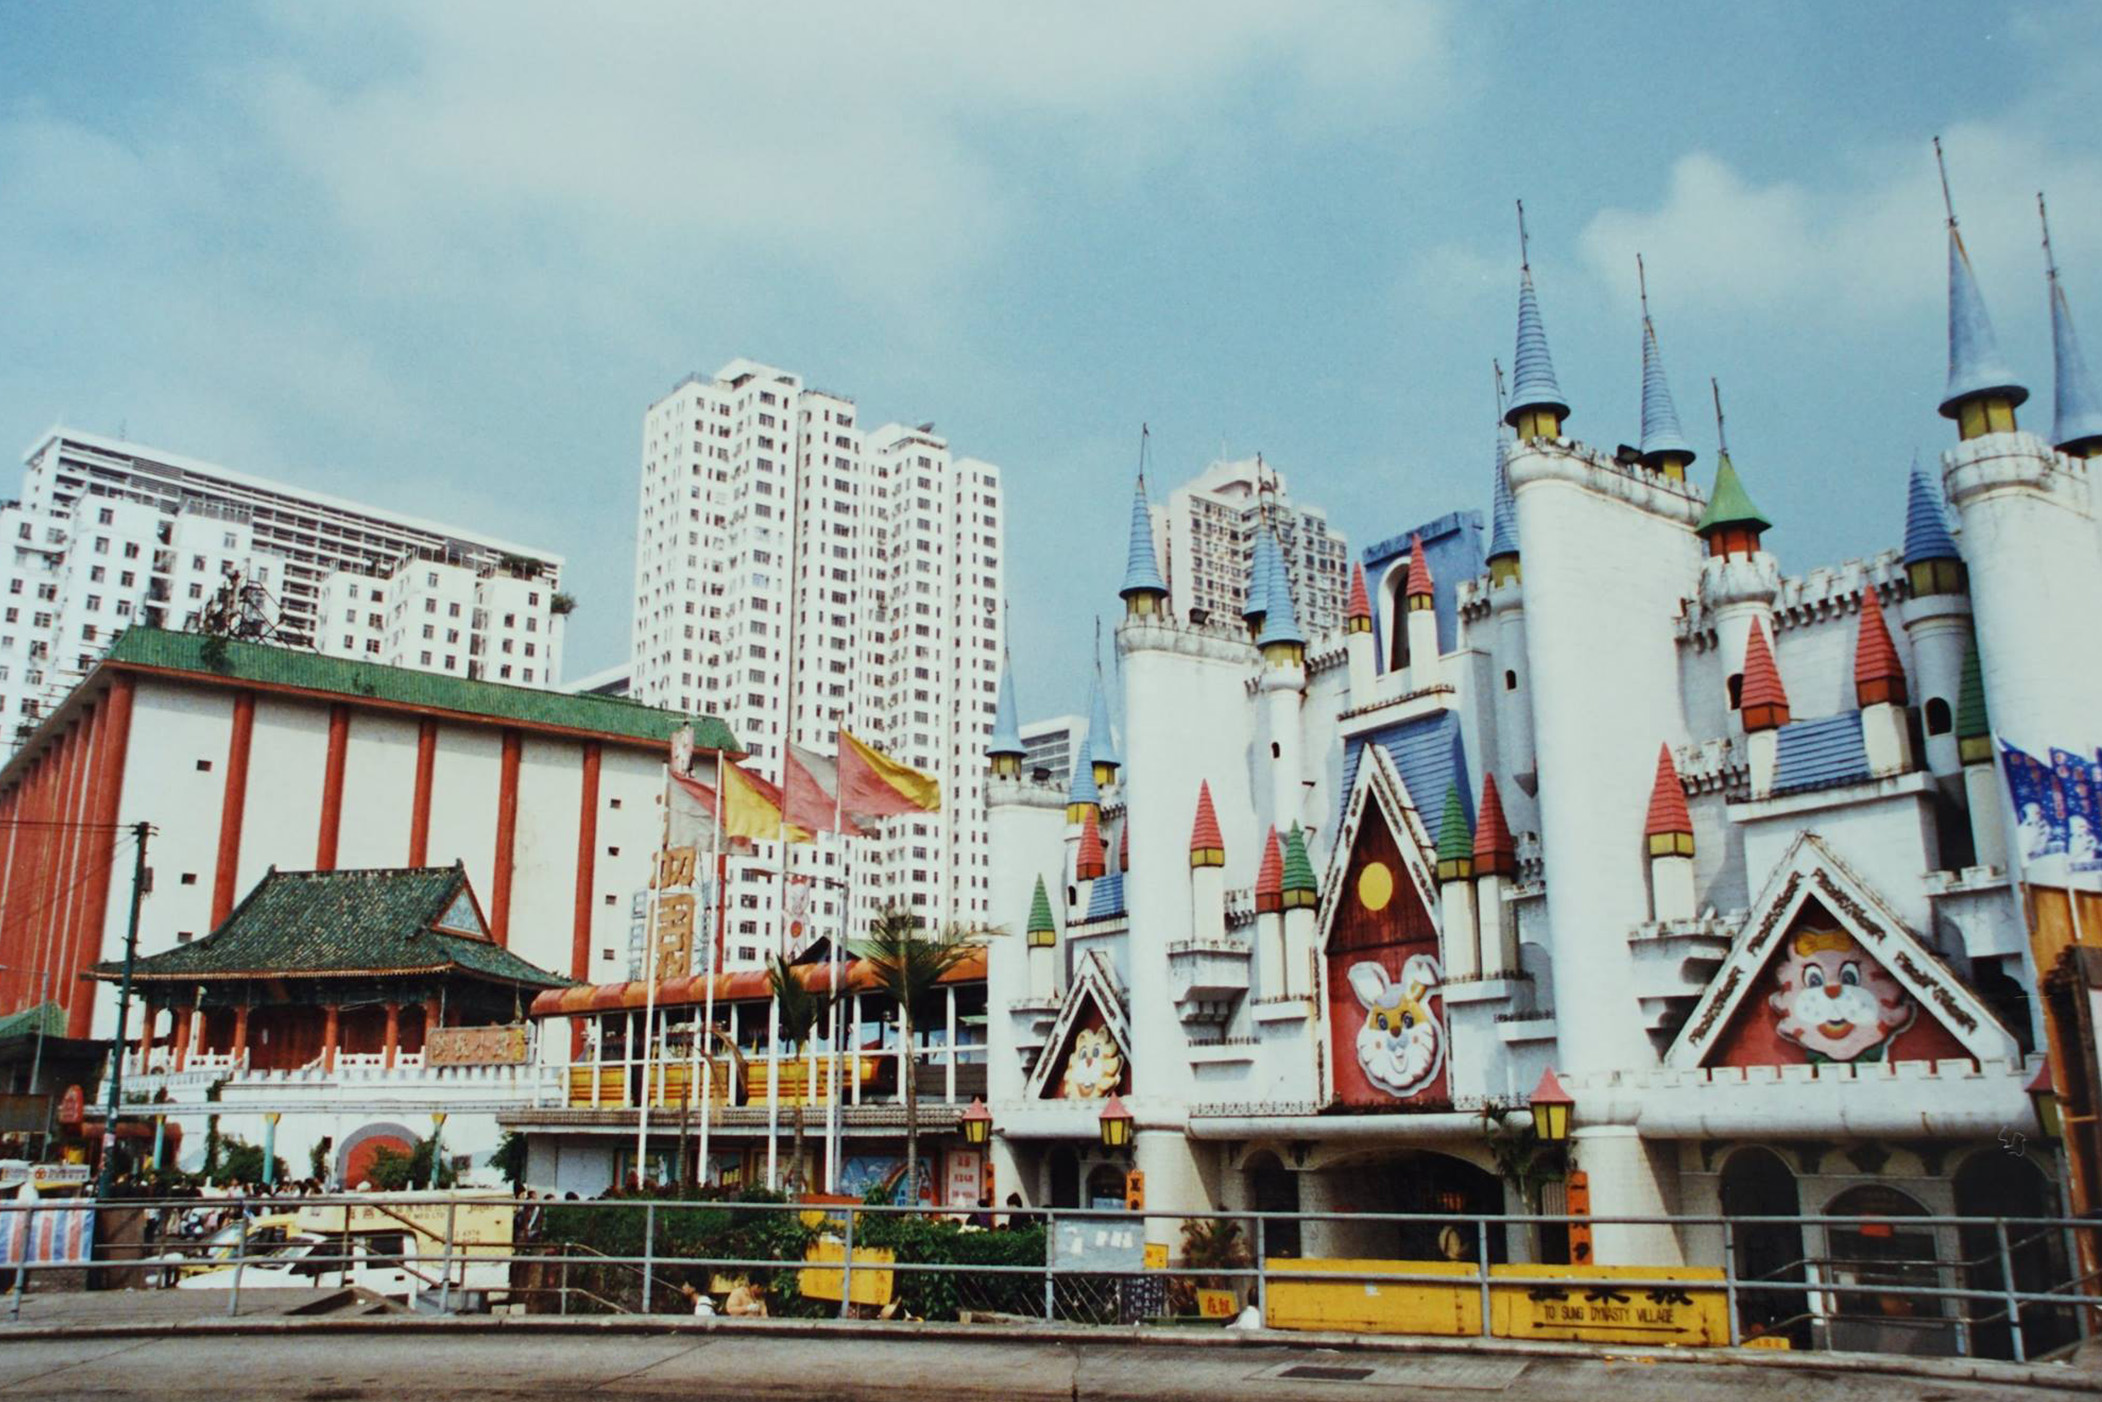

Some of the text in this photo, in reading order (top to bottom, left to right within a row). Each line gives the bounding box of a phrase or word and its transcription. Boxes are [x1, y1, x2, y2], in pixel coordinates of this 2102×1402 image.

[1544, 1305, 1674, 1323] TO SUNG DYNASTY VILLAGE
